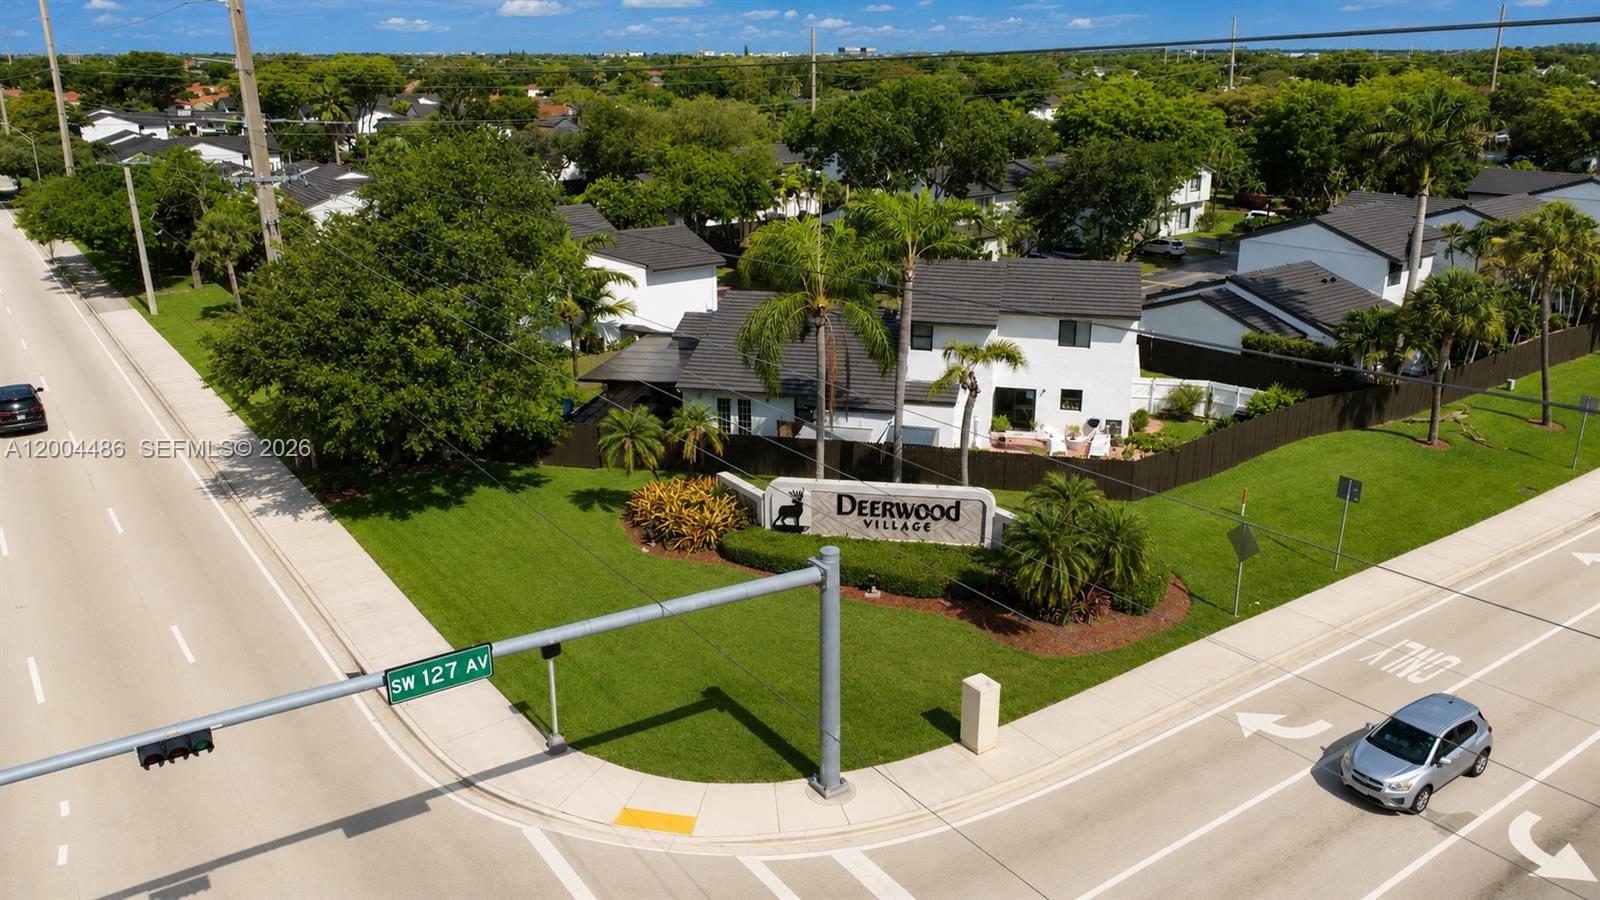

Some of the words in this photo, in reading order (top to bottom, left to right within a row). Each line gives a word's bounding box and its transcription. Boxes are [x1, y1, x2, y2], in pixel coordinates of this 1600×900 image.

[862, 519, 931, 532] VILLAGE
[391, 674, 415, 694] SW
[422, 661, 457, 686] 127
[466, 654, 488, 674] AV
[1358, 639, 1462, 684] ONLY
